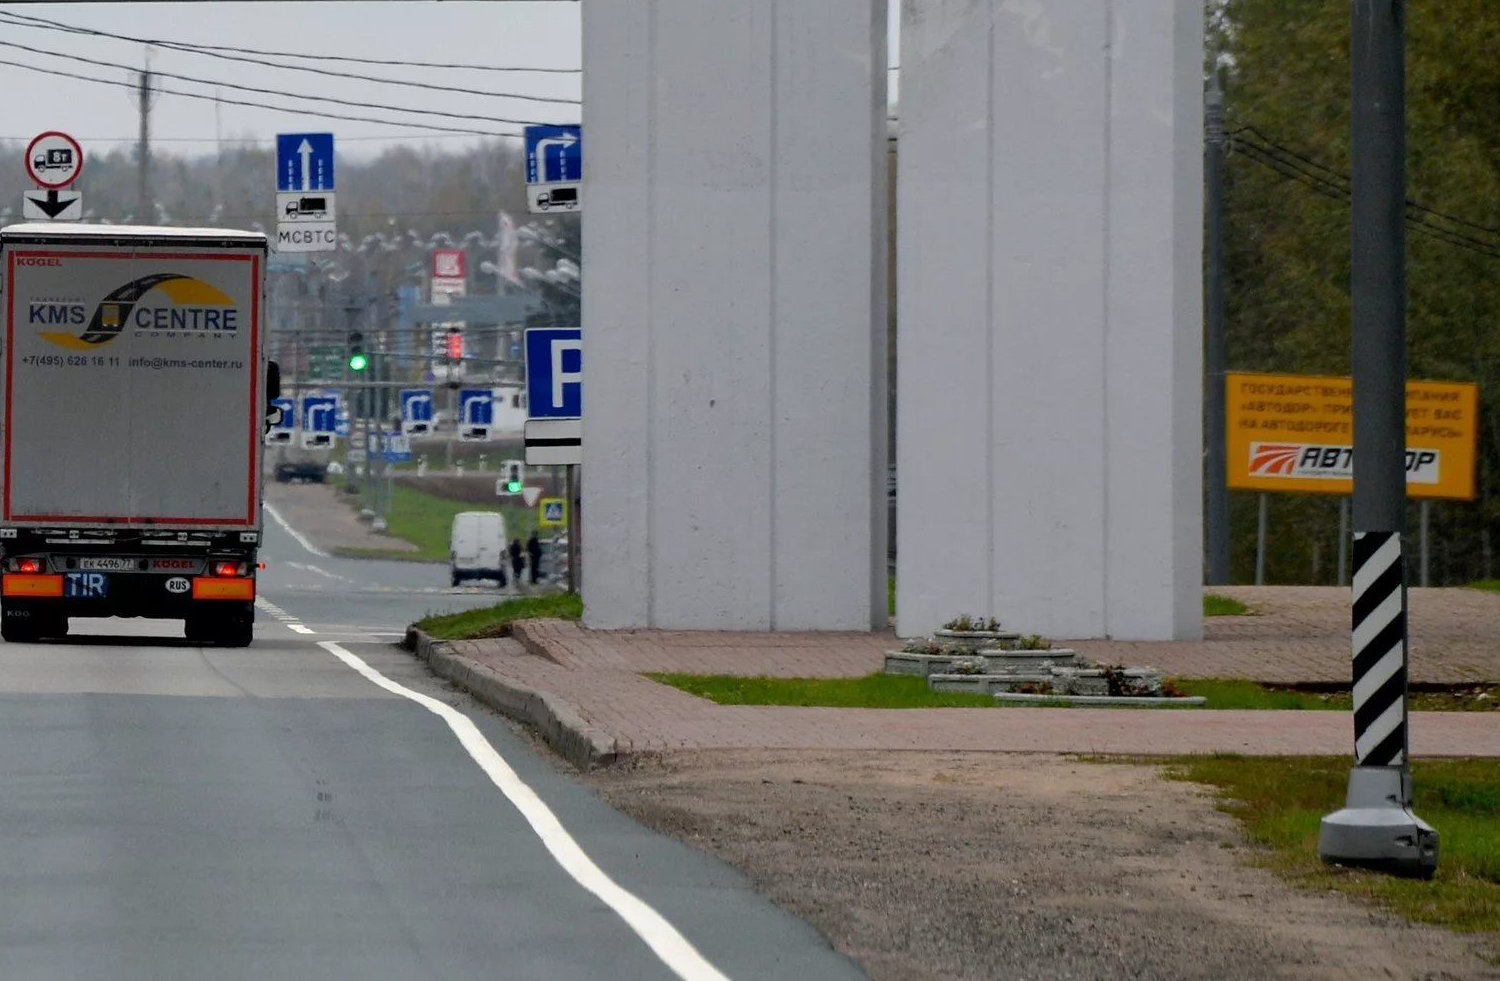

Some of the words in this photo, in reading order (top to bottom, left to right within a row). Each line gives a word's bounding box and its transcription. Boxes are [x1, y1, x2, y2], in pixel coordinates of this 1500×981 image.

[29, 304, 86, 324] KMS
[135, 307, 237, 330] CENTRE
[22, 355, 64, 367] +7(495)
[109, 357, 120, 367] 11
[67, 573, 104, 596] TIR
[169, 579, 188, 591] RUS
